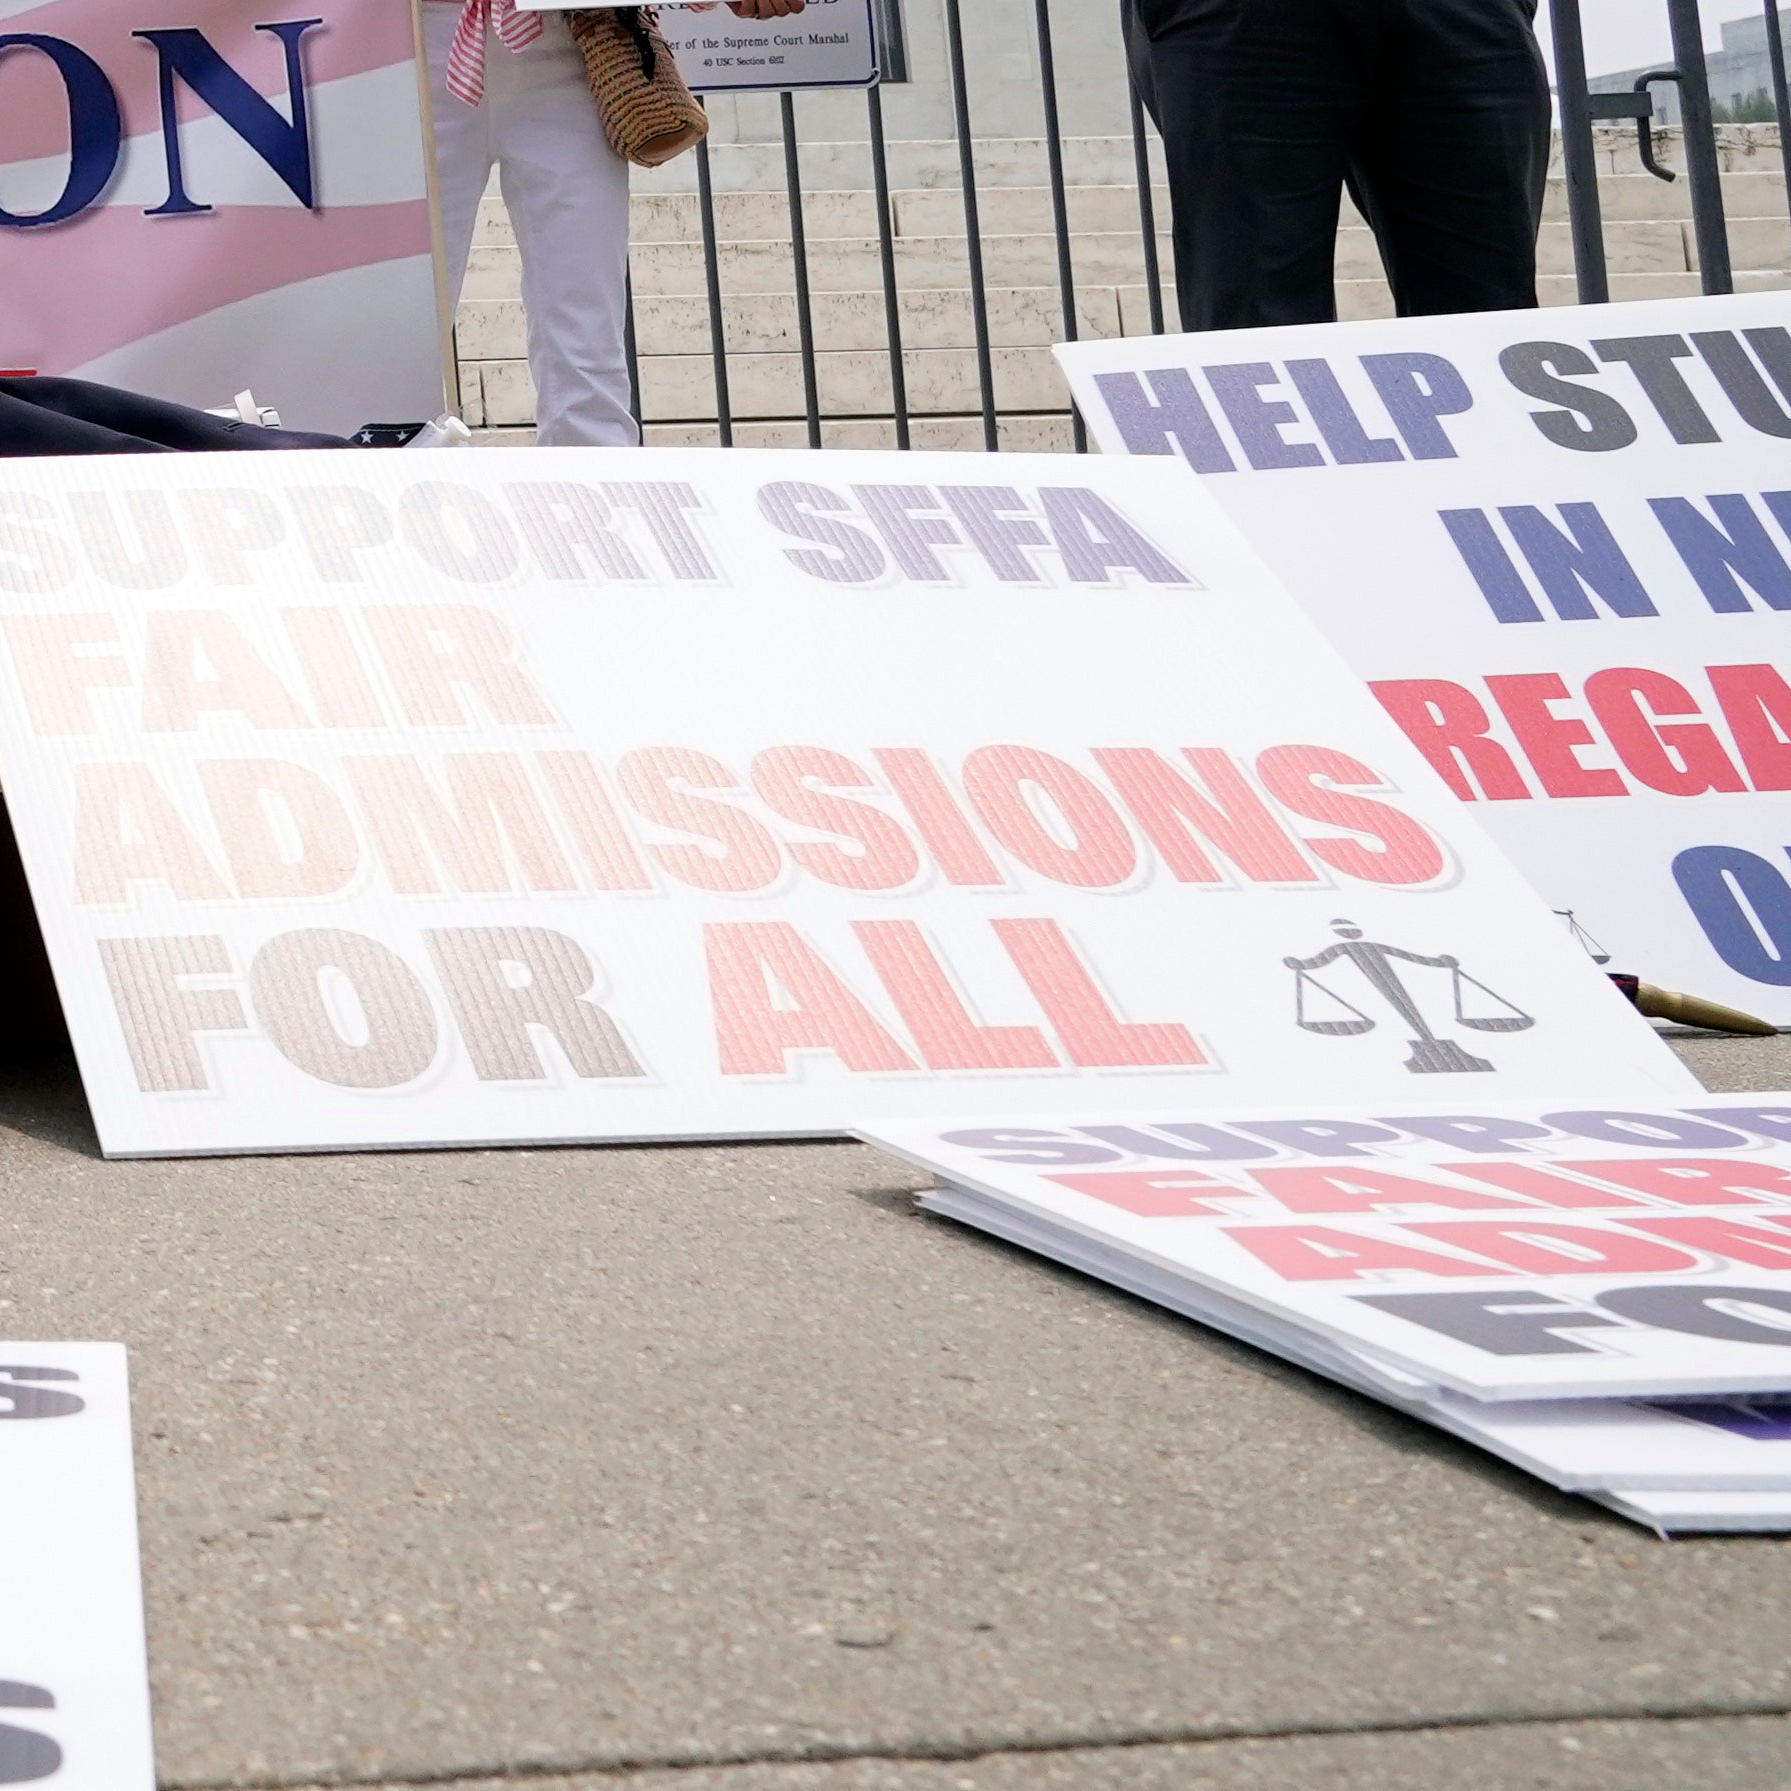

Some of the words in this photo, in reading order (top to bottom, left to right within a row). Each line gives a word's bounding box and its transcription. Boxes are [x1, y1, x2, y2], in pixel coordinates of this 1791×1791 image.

[685, 37, 696, 50] of
[702, 38, 719, 49] the
[723, 36, 769, 51] Supreme
[773, 34, 804, 47] Court
[808, 32, 849, 45] Marshal
[1092, 351, 1475, 475] HELP
[755, 480, 1197, 589] SFFA
[1436, 501, 1661, 624] IN
[0, 600, 559, 738] FAIR
[72, 743, 1449, 908] ADMISSIONS
[95, 926, 652, 1094] FOR
[701, 916, 1211, 1077] ALL
[1040, 1157, 1791, 1218] FAIR
